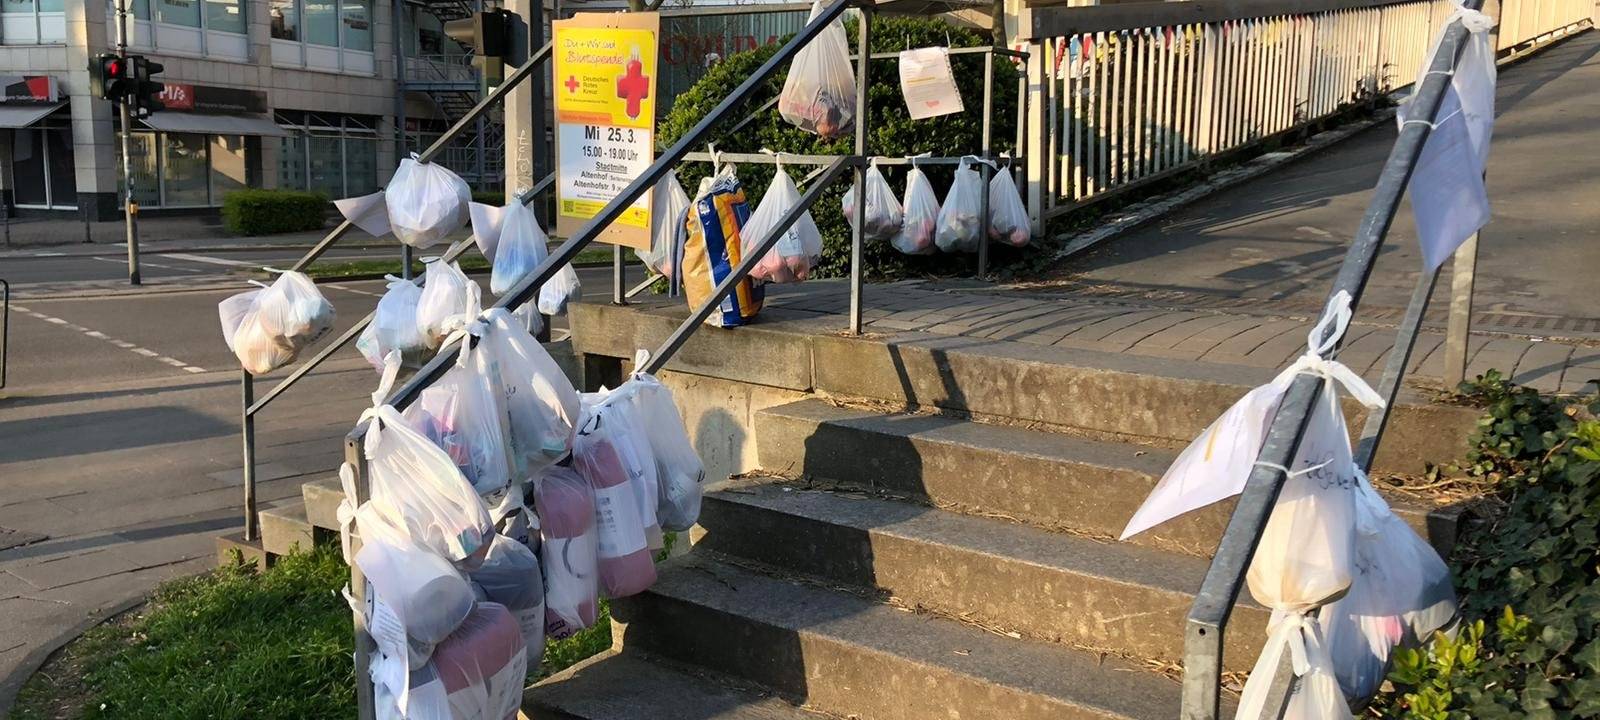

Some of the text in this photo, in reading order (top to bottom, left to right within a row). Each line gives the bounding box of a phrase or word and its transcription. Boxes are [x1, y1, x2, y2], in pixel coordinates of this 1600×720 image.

[585, 125, 636, 143] Mi 25. 3.
[582, 145, 602, 157] 15.00
[609, 148, 626, 160] 19.00
[627, 150, 639, 161] Uhr
[595, 161, 628, 173] Stadtmitte
[581, 170, 608, 181] Altenhof
[611, 183, 616, 191] 9
